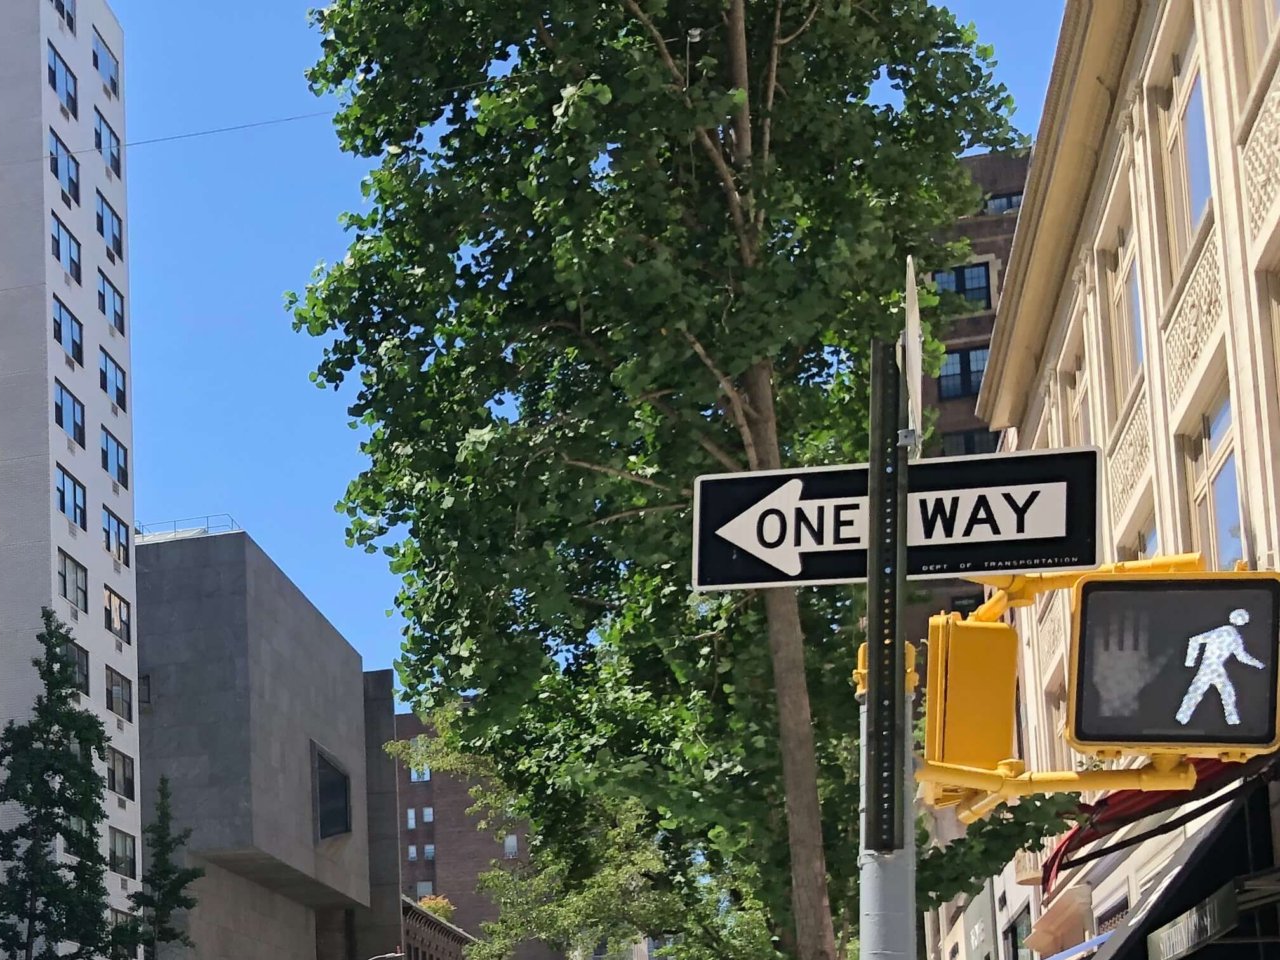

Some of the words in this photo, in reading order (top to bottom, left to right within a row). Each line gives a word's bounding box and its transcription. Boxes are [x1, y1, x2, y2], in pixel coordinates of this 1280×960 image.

[756, 504, 862, 549] ONE
[919, 490, 1041, 539] WAY
[984, 556, 1078, 568] TRANSPORTATION
